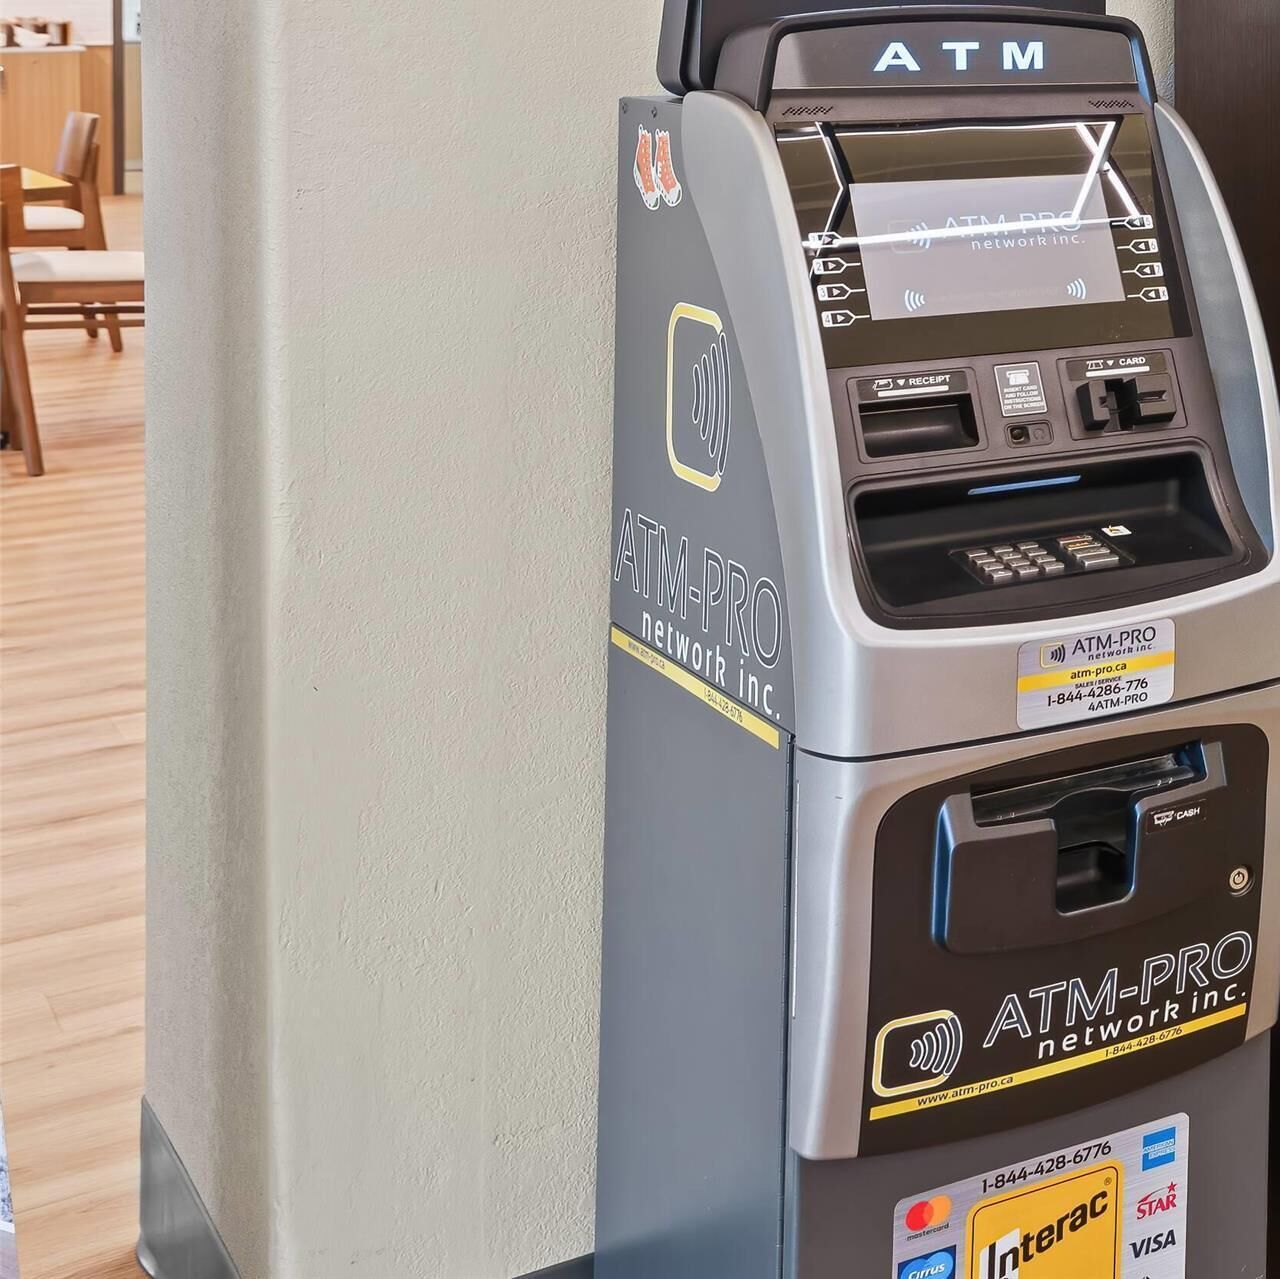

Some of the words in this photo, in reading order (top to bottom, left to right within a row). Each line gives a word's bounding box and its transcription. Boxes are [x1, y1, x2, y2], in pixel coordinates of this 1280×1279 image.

[873, 40, 1046, 73] ATM
[971, 234, 1047, 251] network
[1052, 232, 1087, 246] inc.
[1119, 356, 1146, 367] CARD
[909, 375, 950, 386] RECEIPT
[614, 508, 783, 669] ATM-PRO
[1072, 626, 1157, 656] ATM-PRO
[1088, 646, 1134, 661] network
[641, 609, 727, 688] network
[738, 655, 781, 721] inc.
[1070, 662, 1128, 680] atm-pro.ca
[1047, 677, 1149, 707] 1-844-4286-776
[1075, 680, 1094, 689] SALES
[1098, 676, 1122, 686] SERVICE
[1088, 691, 1148, 712] 4ATM-PRO
[1176, 807, 1201, 820] CASH
[982, 930, 1253, 1048] ATM-PRO
[1037, 1003, 1180, 1060] network
[1191, 979, 1247, 1015] inc.
[917, 1075, 1014, 1107] www.atm-pro.ca
[1104, 1026, 1184, 1058] 1-844-428-6776
[981, 1140, 1112, 1194] 1-844-428-6776
[1136, 1190, 1178, 1221] STAR
[906, 1222, 950, 1241] mastercard
[988, 1189, 1109, 1279] Interac
[1129, 1228, 1177, 1260] VISA
